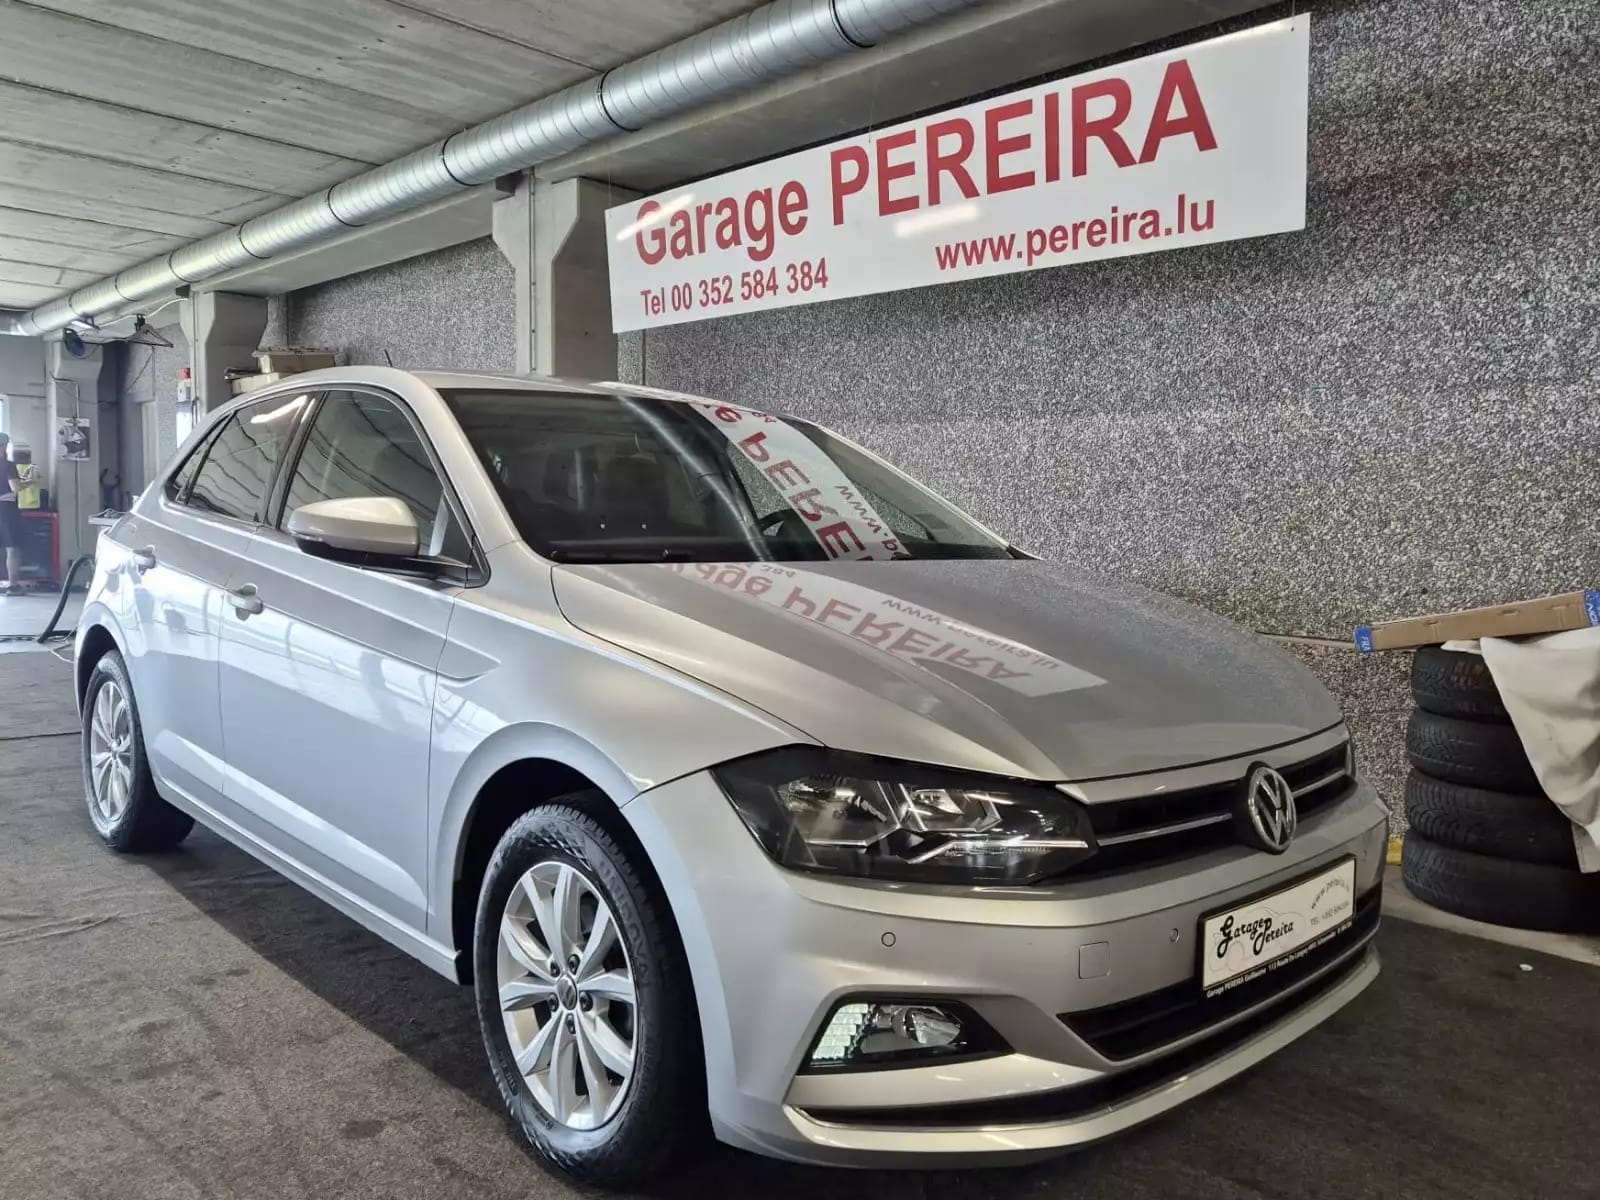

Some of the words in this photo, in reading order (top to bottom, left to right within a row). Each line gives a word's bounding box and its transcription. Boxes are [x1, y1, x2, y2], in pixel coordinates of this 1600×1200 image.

[635, 179, 808, 264] Garage
[830, 59, 1217, 226] PEREIRA
[935, 194, 1216, 271] www.pereira.lu
[640, 285, 667, 315] Tel
[670, 281, 693, 311] 00
[698, 276, 733, 307] 352
[740, 267, 779, 299] 584
[786, 257, 829, 292] 384
[1216, 914, 1265, 959] Garage
[1252, 916, 1294, 956] Pereira
